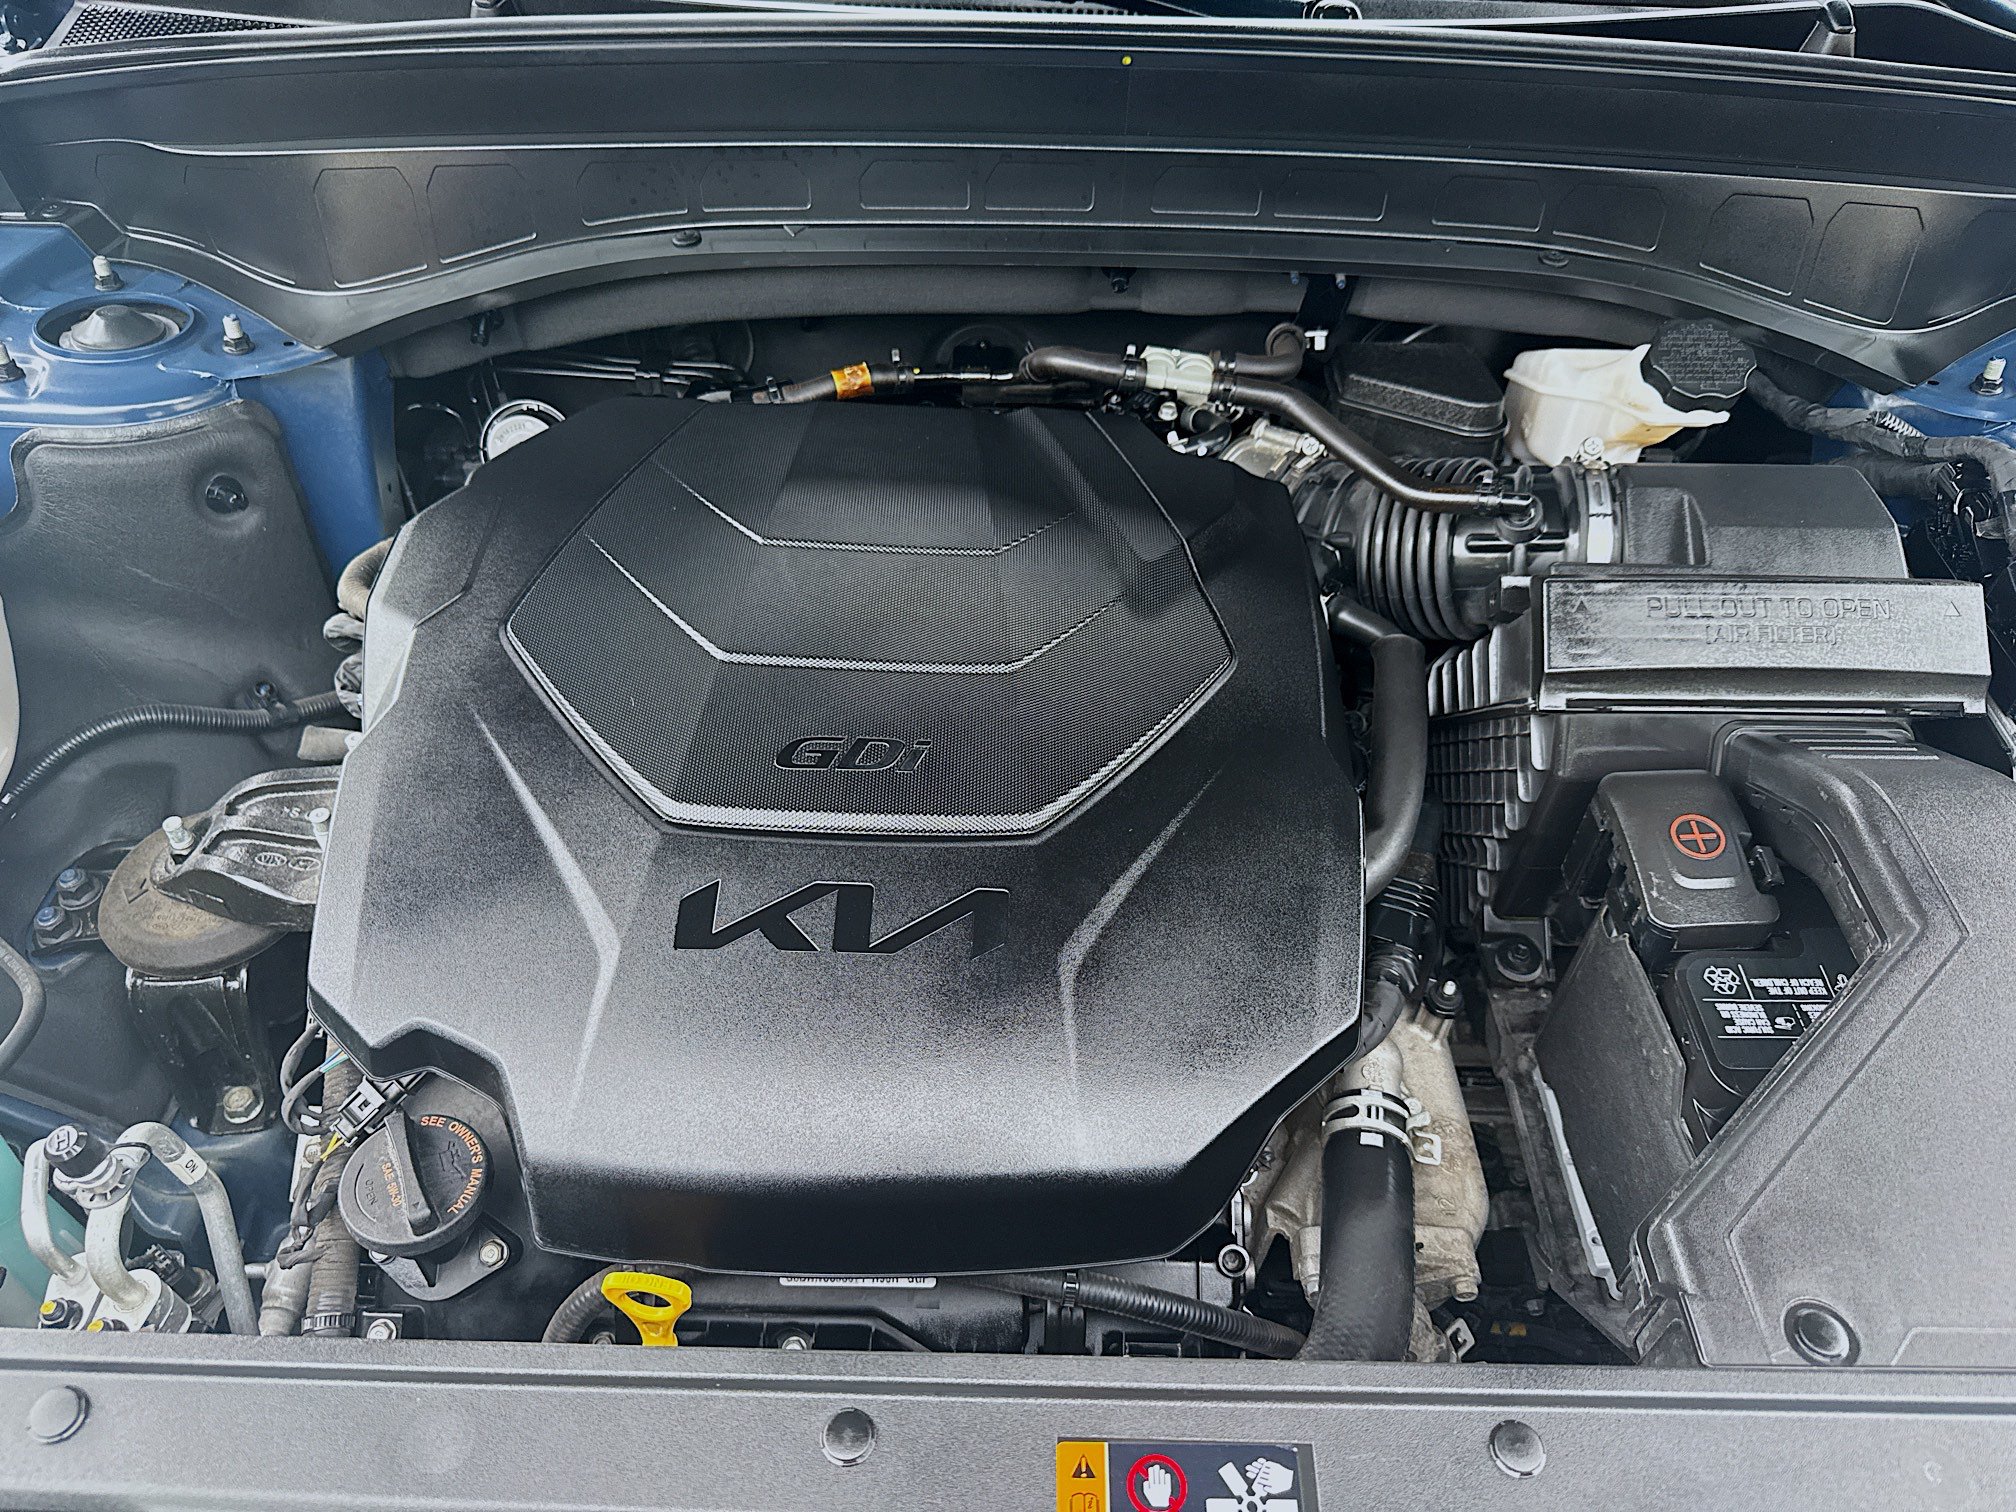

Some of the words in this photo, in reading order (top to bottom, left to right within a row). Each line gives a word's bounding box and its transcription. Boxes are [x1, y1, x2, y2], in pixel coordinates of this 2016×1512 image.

[1647, 596, 1714, 619] PULL
[1721, 597, 1771, 619] OUT
[1780, 597, 1814, 619] TO
[1823, 598, 1891, 619] OPEN
[774, 735, 932, 772] GDi
[674, 879, 1010, 960] KIA
[421, 1116, 446, 1128] SEE
[449, 1121, 484, 1164] OWNER'S
[382, 1163, 394, 1181] SAE
[365, 1180, 377, 1205] OPEN
[387, 1182, 402, 1207] 5W-30
[447, 1168, 483, 1215] MANUAL
